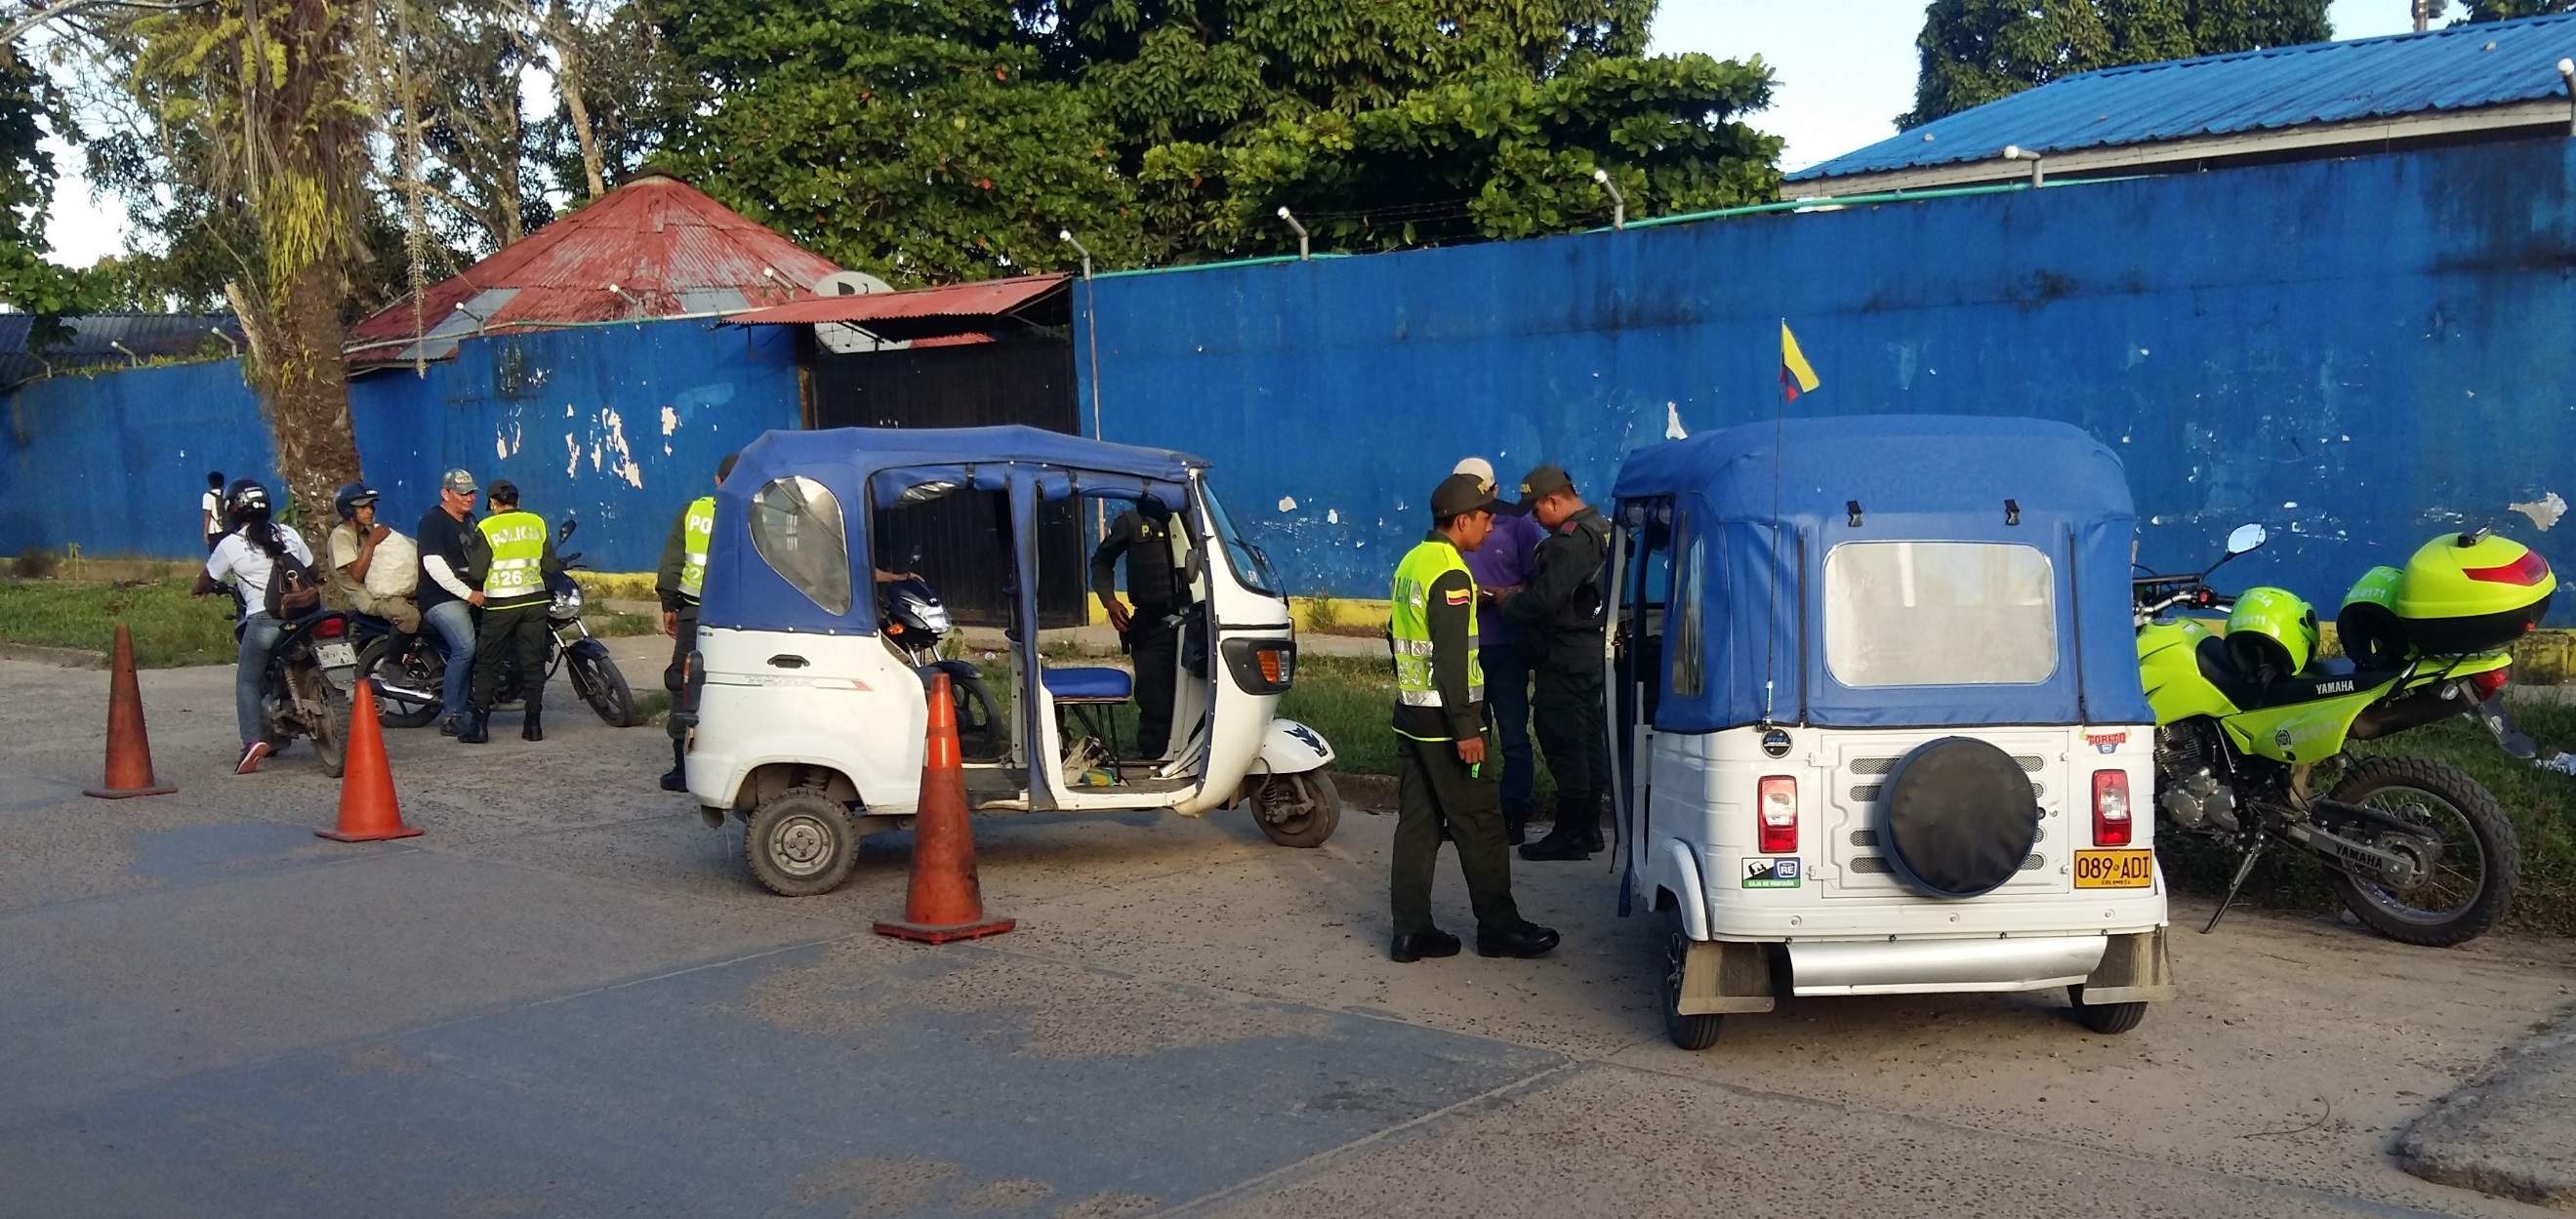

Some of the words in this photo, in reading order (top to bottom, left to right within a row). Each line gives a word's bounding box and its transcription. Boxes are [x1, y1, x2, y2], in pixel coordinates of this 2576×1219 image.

[2315, 680, 2354, 695] YAMAHA
[2086, 731, 2127, 747] TORITO
[2335, 842, 2383, 870] YAMAHA
[1779, 865, 1795, 874] RE
[2077, 857, 2113, 879] 089
[2119, 856, 2149, 879] ADI
